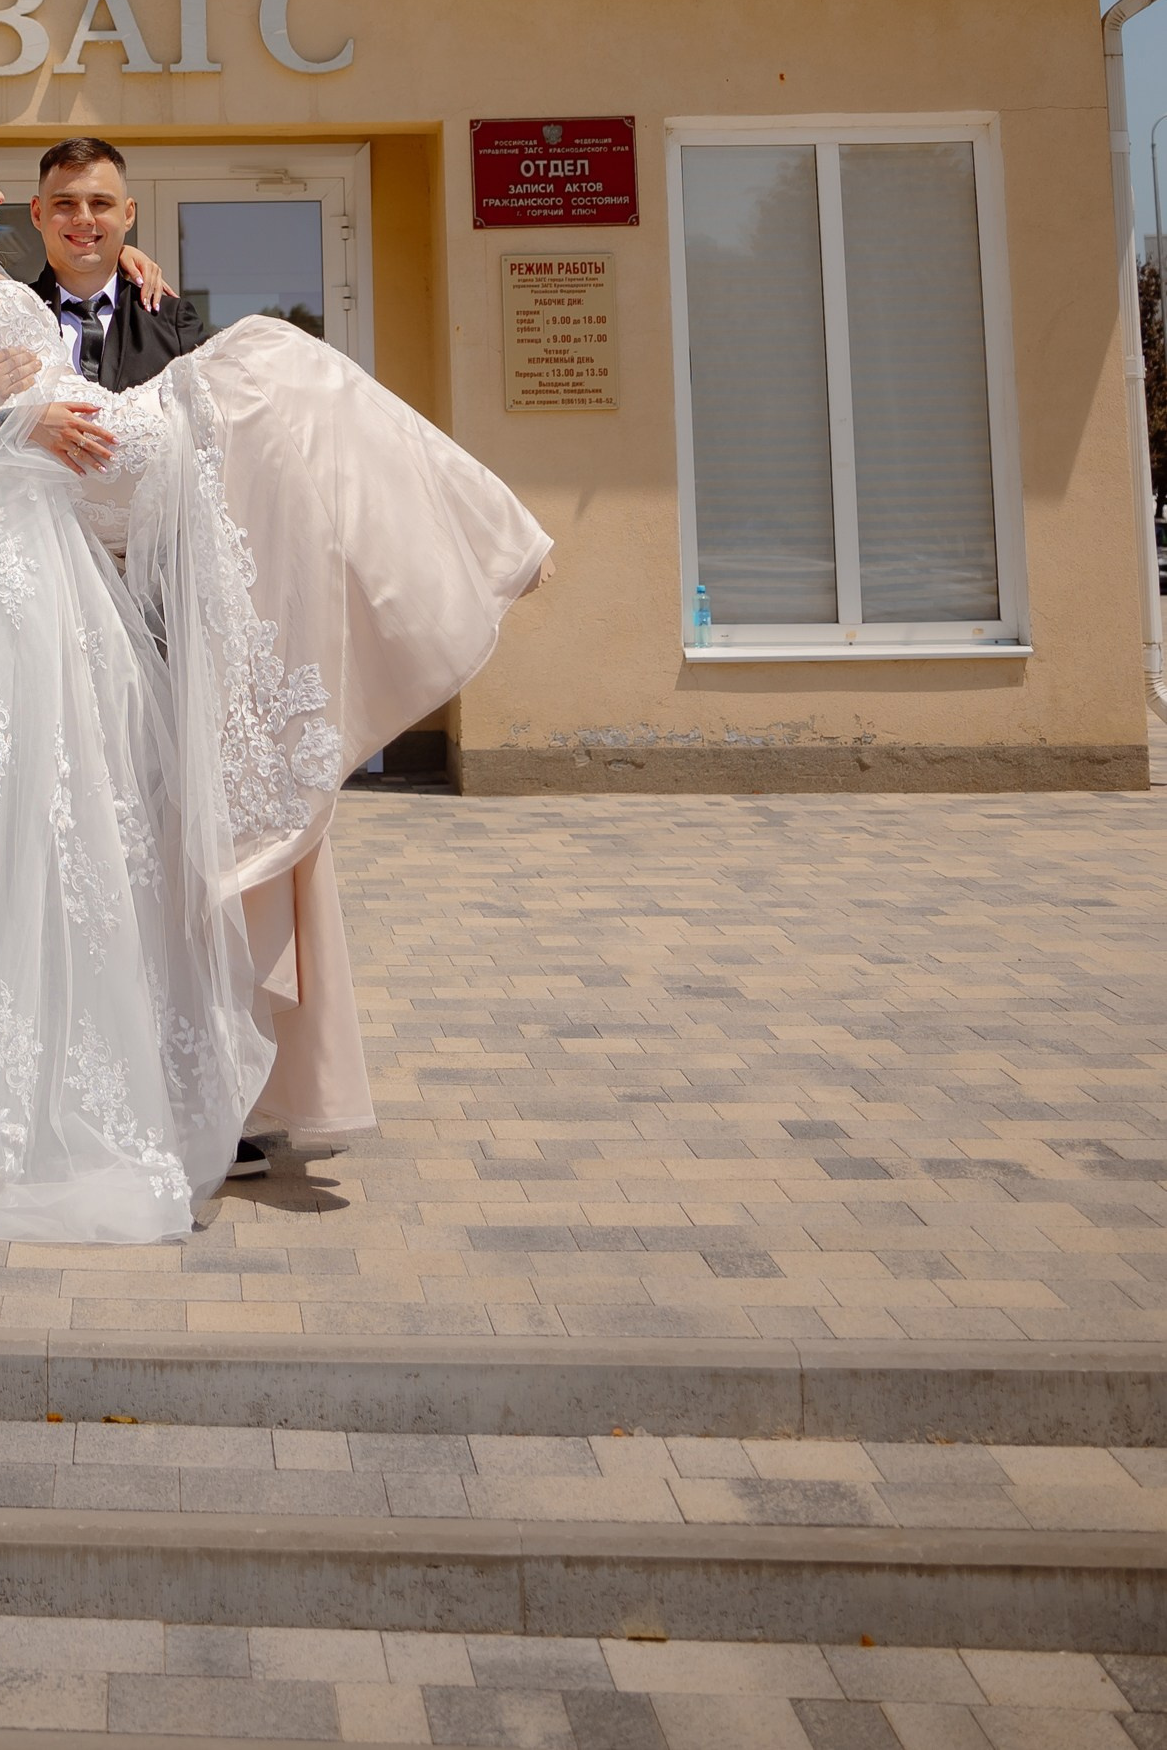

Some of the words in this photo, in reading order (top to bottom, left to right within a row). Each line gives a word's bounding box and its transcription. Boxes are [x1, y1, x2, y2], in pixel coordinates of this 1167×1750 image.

[520, 160, 589, 178] ОТДЕЛ
[508, 184, 554, 194] ЗАПИСИ
[565, 183, 603, 192] АКТОВ
[483, 197, 563, 207] ГРАЖДАНСКОГО
[571, 196, 629, 205] СОСТОЯНИЯ
[527, 208, 563, 216] ГОРЯЧИЙ
[510, 263, 553, 275] РЕЖИМ
[558, 261, 605, 275] РАБОТЫ
[567, 298, 584, 306] ДНИ:
[552, 316, 570, 324] 9.00
[582, 315, 606, 324] 18.00
[552, 335, 571, 343] 9.00
[584, 334, 607, 342] 17.00
[552, 369, 574, 377] 13.00
[586, 368, 608, 376] 13.50
